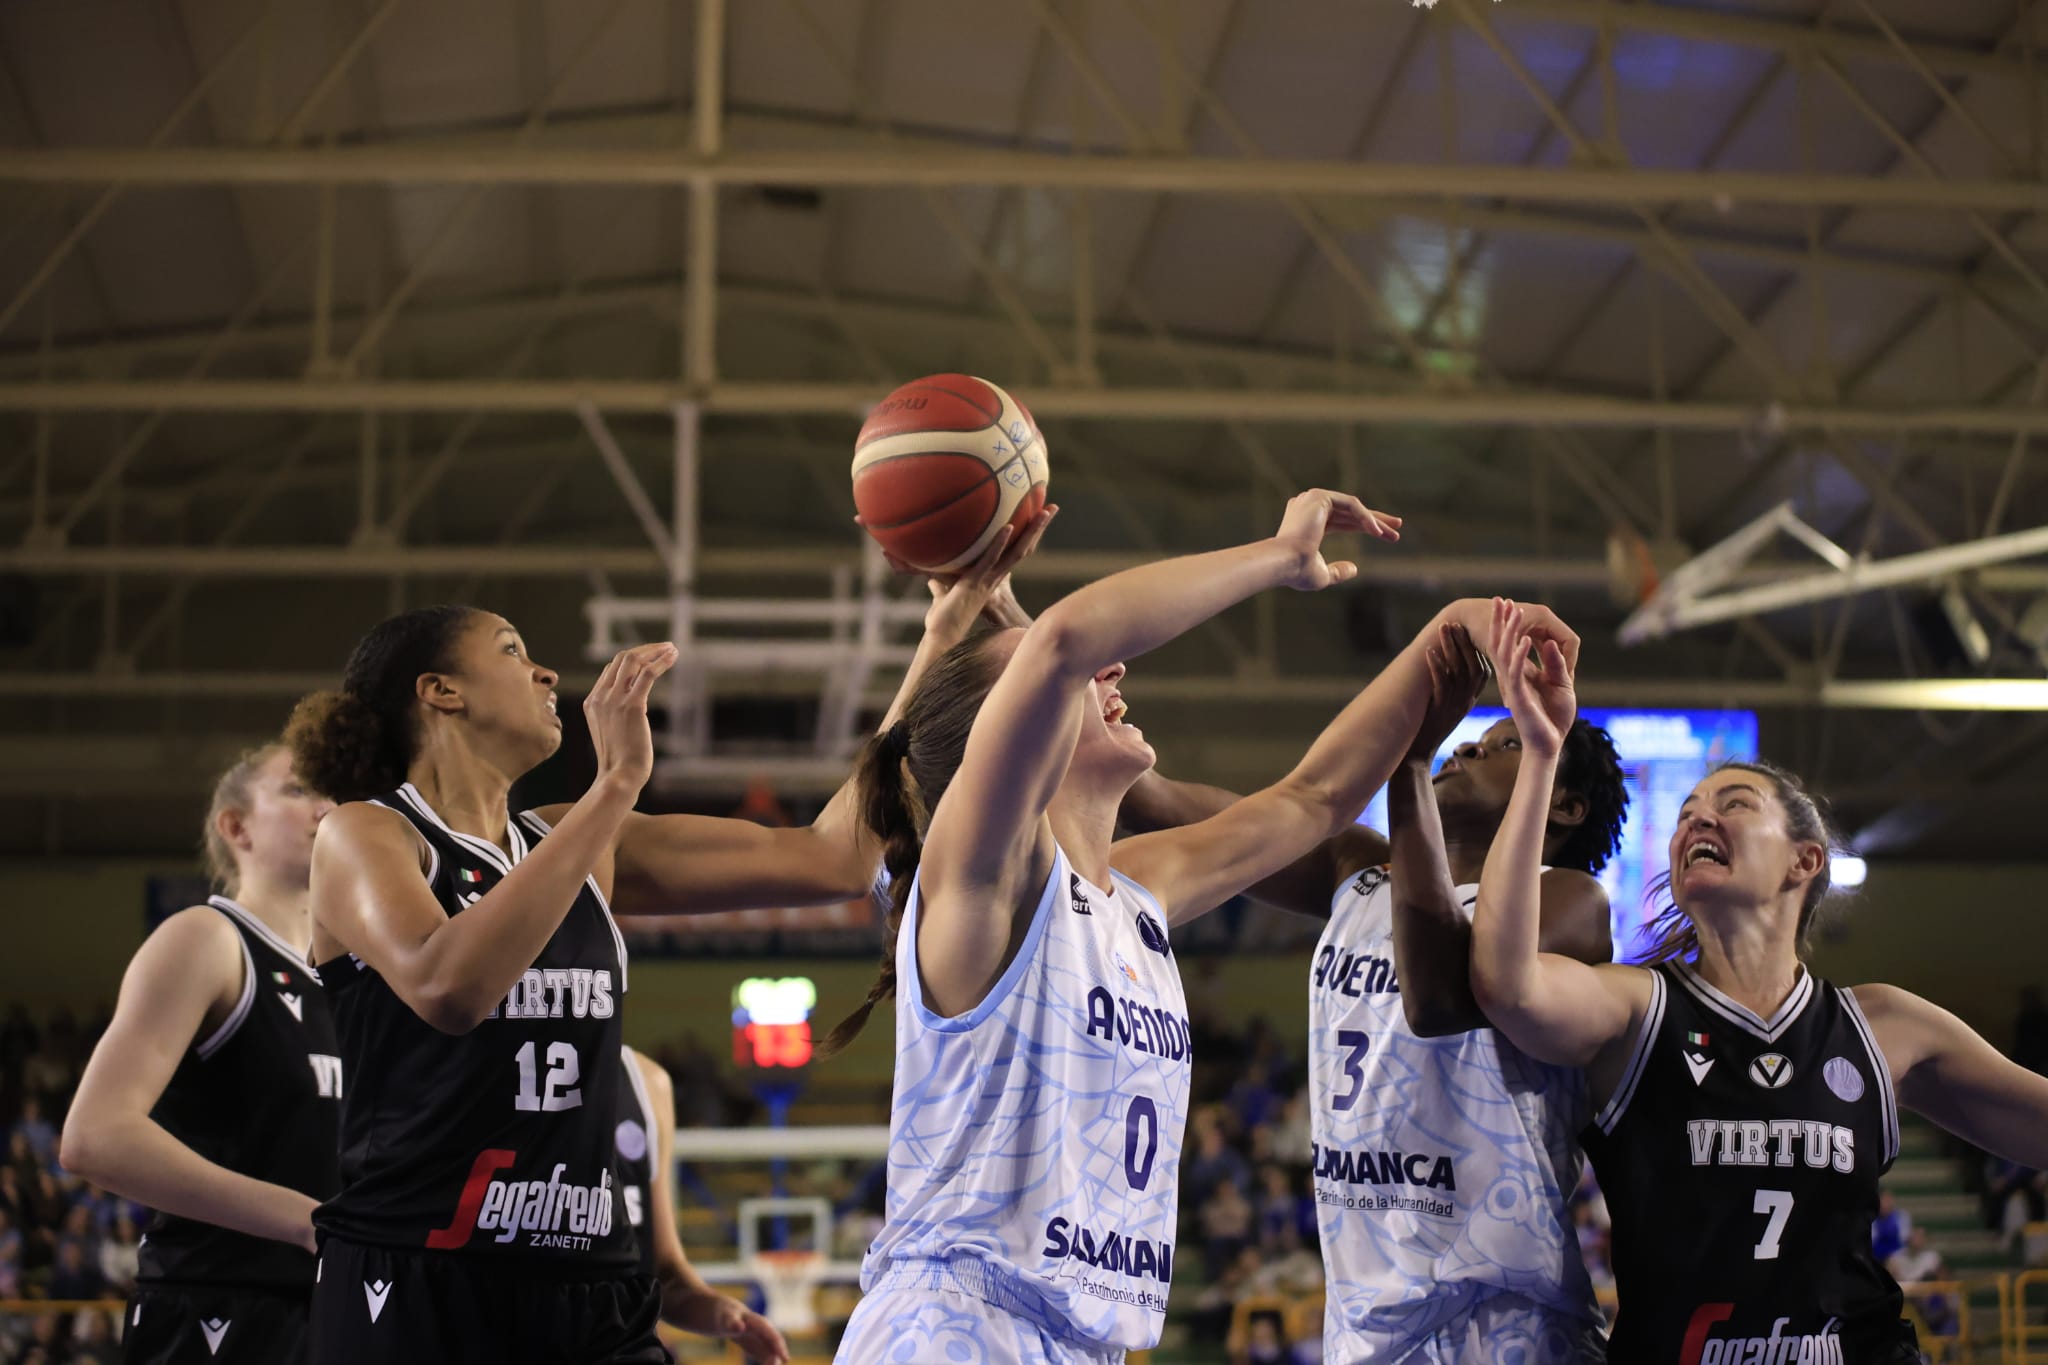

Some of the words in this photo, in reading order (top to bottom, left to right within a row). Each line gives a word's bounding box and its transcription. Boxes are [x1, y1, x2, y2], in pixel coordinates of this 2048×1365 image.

[1072, 899, 1091, 913] err
[487, 968, 614, 1019] IRTUS
[1314, 945, 1400, 998] AVEN
[515, 1041, 583, 1112] 12
[1332, 1030, 1370, 1111] 3
[1125, 1095, 1158, 1191] 0
[1687, 1119, 1855, 1174] VIRTUS
[425, 1148, 612, 1249] Segafredo
[1358, 1195, 1374, 1208] de
[1376, 1195, 1388, 1208] la
[1753, 1189, 1795, 1259] 7
[529, 1234, 591, 1250] ZANETTI
[1082, 1277, 1135, 1303] Patrimonio
[1138, 1290, 1153, 1305] de
